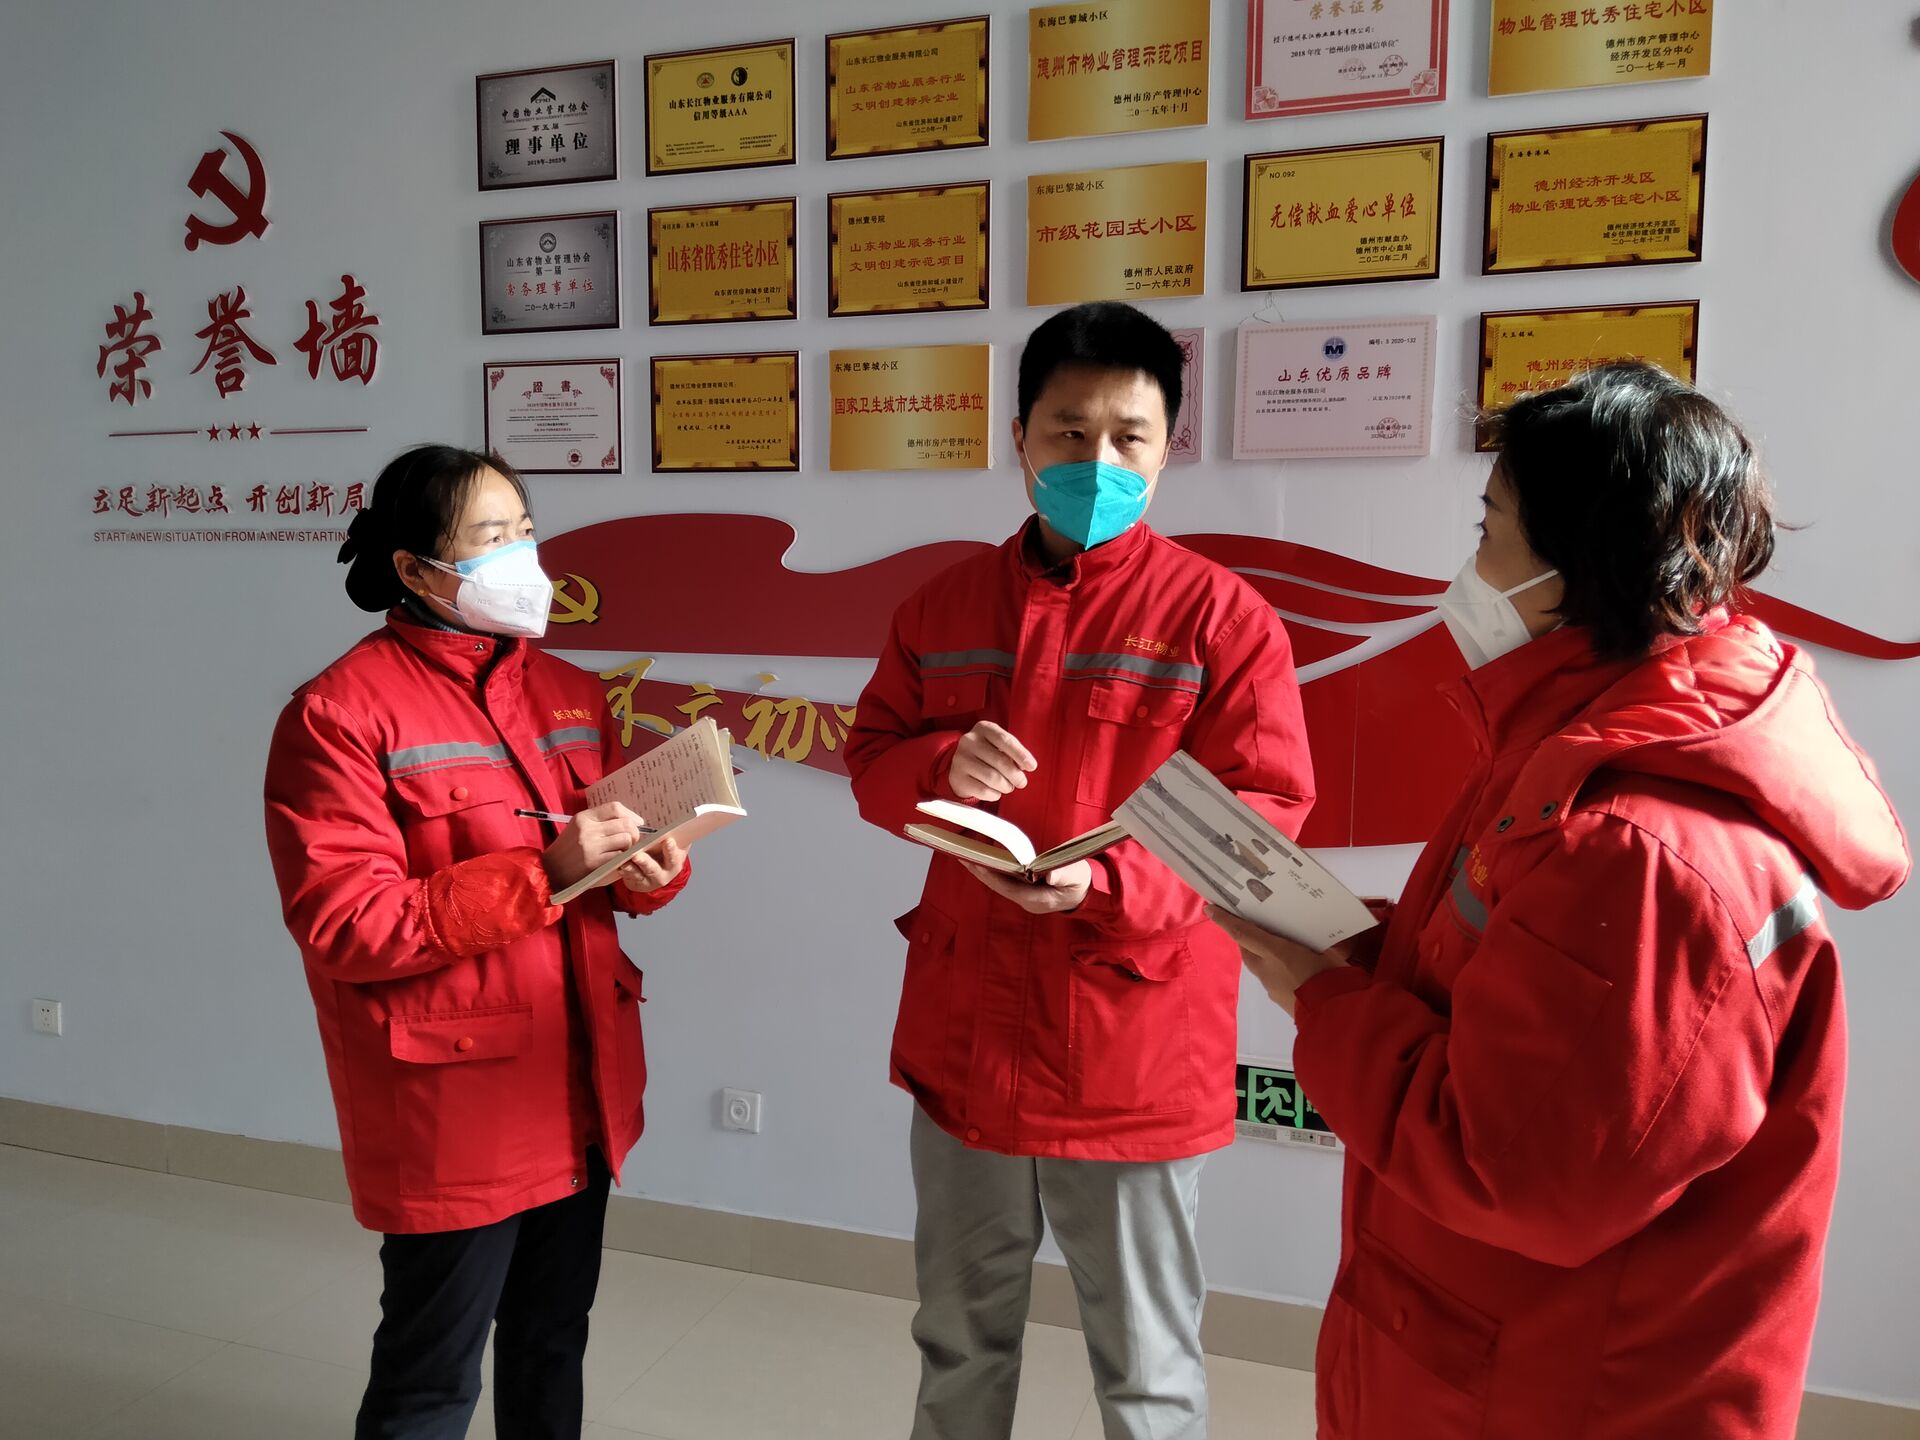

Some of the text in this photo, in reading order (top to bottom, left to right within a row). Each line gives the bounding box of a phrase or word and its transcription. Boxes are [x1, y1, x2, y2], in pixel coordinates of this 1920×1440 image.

[1038, 10, 1108, 28] 东海巴黎城小区
[1310, 0, 1385, 20] 荣誉证书
[1498, 0, 1707, 36] 物业管理优秀住宅小区
[1606, 31, 1700, 48] 德州市房产管理中心
[846, 48, 938, 66] 山东长江物业服务有限公司
[1038, 40, 1202, 80] 德州市物业管理示范项目
[1610, 45, 1694, 62] 经济开发区分中心
[846, 73, 966, 94] 山东省物业服务行业
[669, 90, 772, 110] 山东长江物业服务有限公司
[852, 92, 959, 112] 文明创建标兵企业
[1113, 87, 1202, 105] 德州市房产管理中心
[502, 101, 588, 120] 中国物业管理协会
[694, 108, 748, 121] 信用等级AAA
[505, 132, 588, 155] 理事单位
[1036, 180, 1104, 195] 东海巴黎城小区
[1534, 172, 1656, 192] 德州经济开发区
[1270, 193, 1416, 228] 无偿献血爱心单位
[1508, 190, 1682, 214] 物业管理优秀住宅小区
[848, 216, 885, 226] 德州壹号院
[1036, 215, 1197, 243] 市级花园式小区
[1607, 220, 1676, 231] 德州经济技术开发区
[850, 235, 966, 252] 山东物业服务行业
[1360, 234, 1408, 245] 德州市献血办
[668, 240, 779, 272] 山东省优秀住宅小区
[1356, 244, 1412, 254] 德州市中心血站
[506, 252, 590, 268] 山东省物业管理协会
[850, 255, 964, 272] 文明创建示范项目
[536, 266, 562, 276] 第一届
[1124, 264, 1194, 278] 德州市人民政府
[506, 279, 594, 296] 常务理事单位
[96, 274, 381, 406] 荣誉墙
[834, 361, 898, 372] 东海巴黎城小区
[1278, 364, 1392, 383] 山东优质品牌
[834, 392, 984, 414] 国家卫生城市先进模范单位
[908, 438, 982, 448] 德州市房产管理中心
[92, 481, 365, 518] 立足新起点 开创新局
[94, 532, 126, 542] START
[140, 532, 162, 541] NEW
[166, 532, 221, 541] SITUATION
[225, 532, 256, 541] FROM
[270, 531, 296, 540] NEW
[298, 531, 348, 540] STARTIN
[1124, 635, 1180, 657] 长江物业
